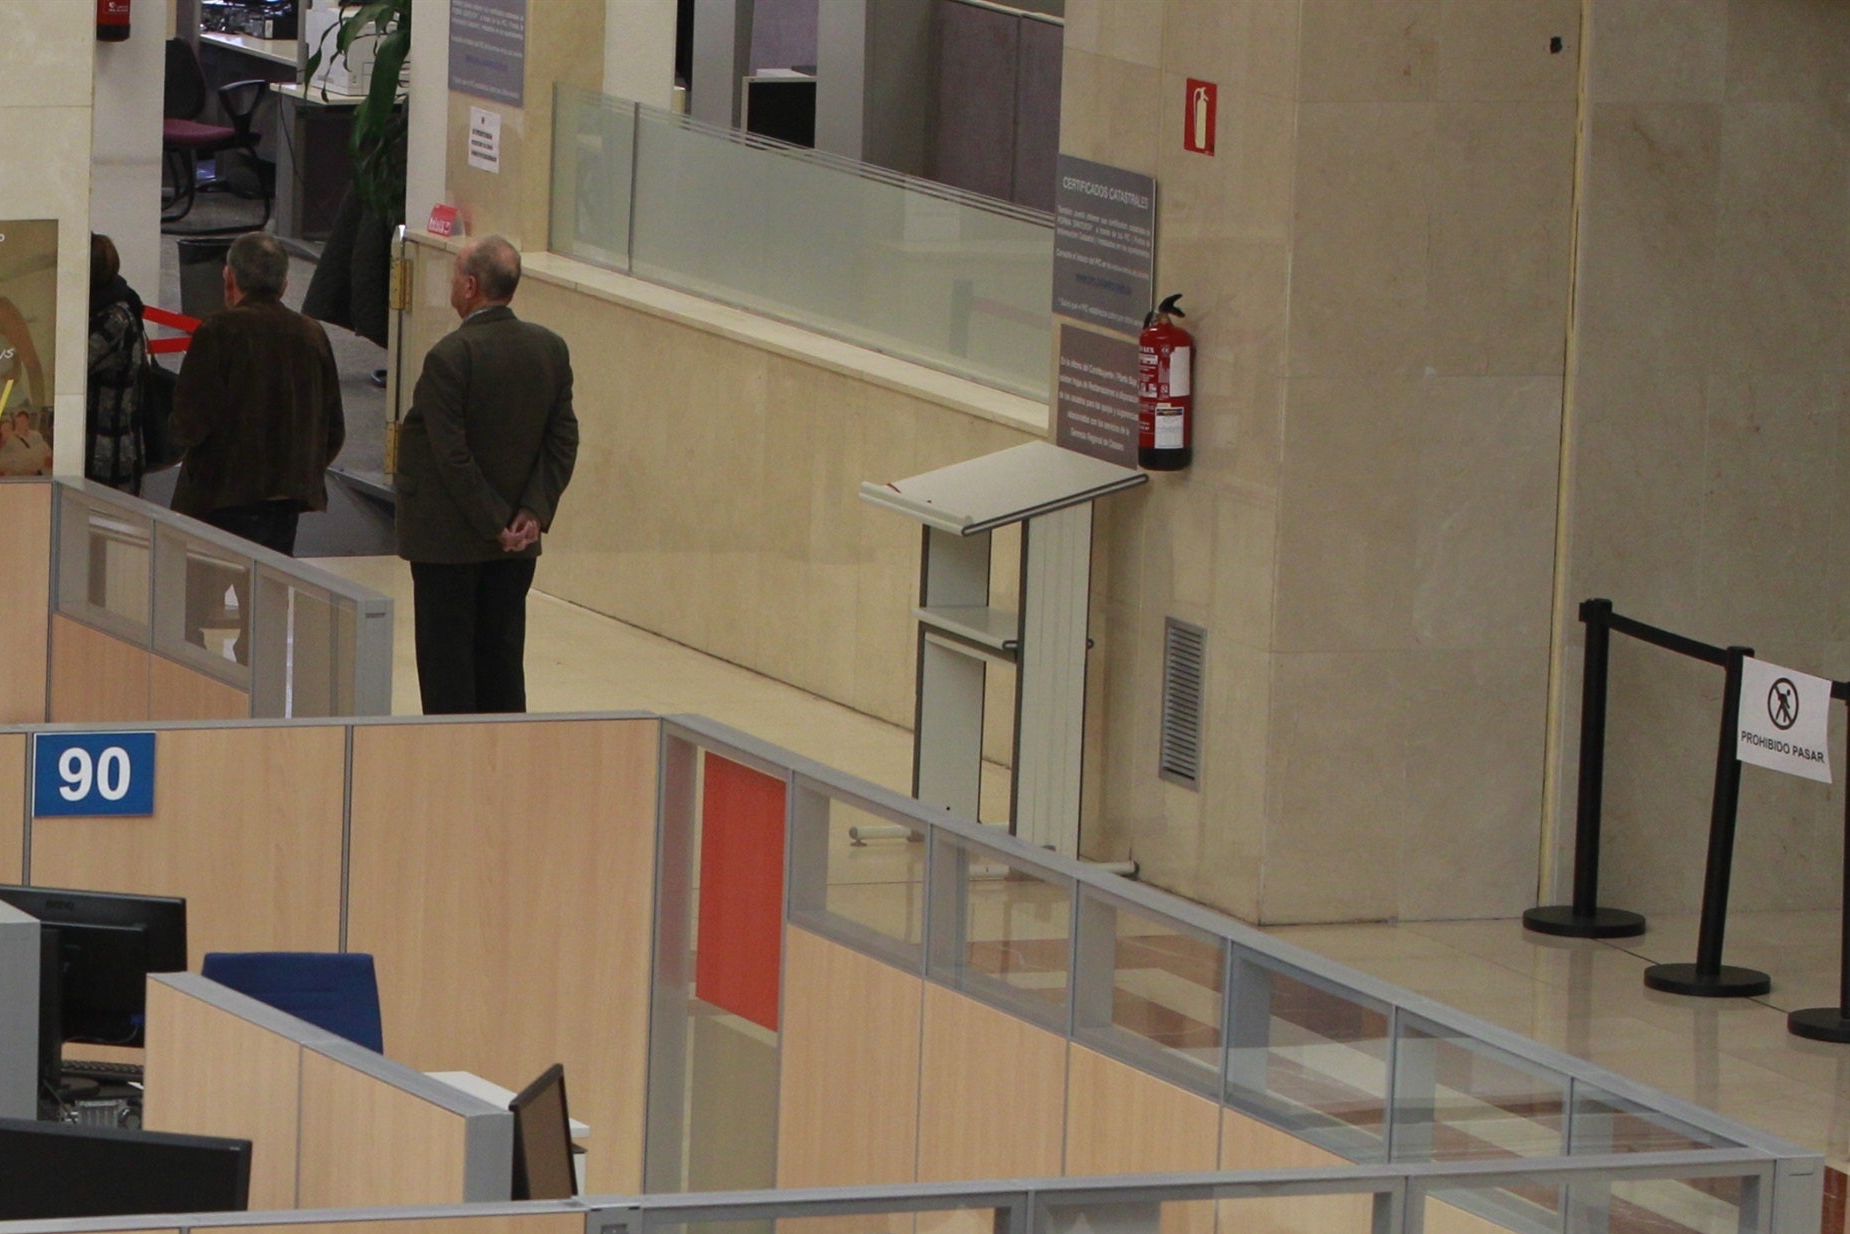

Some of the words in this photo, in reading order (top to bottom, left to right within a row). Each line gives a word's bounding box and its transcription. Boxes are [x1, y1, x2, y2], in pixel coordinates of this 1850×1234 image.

[1062, 176, 1108, 200] CERTIFICADOS
[1741, 730, 1790, 754] PROHIBIDO
[1792, 745, 1825, 763] PASAR
[59, 746, 131, 801] 90
